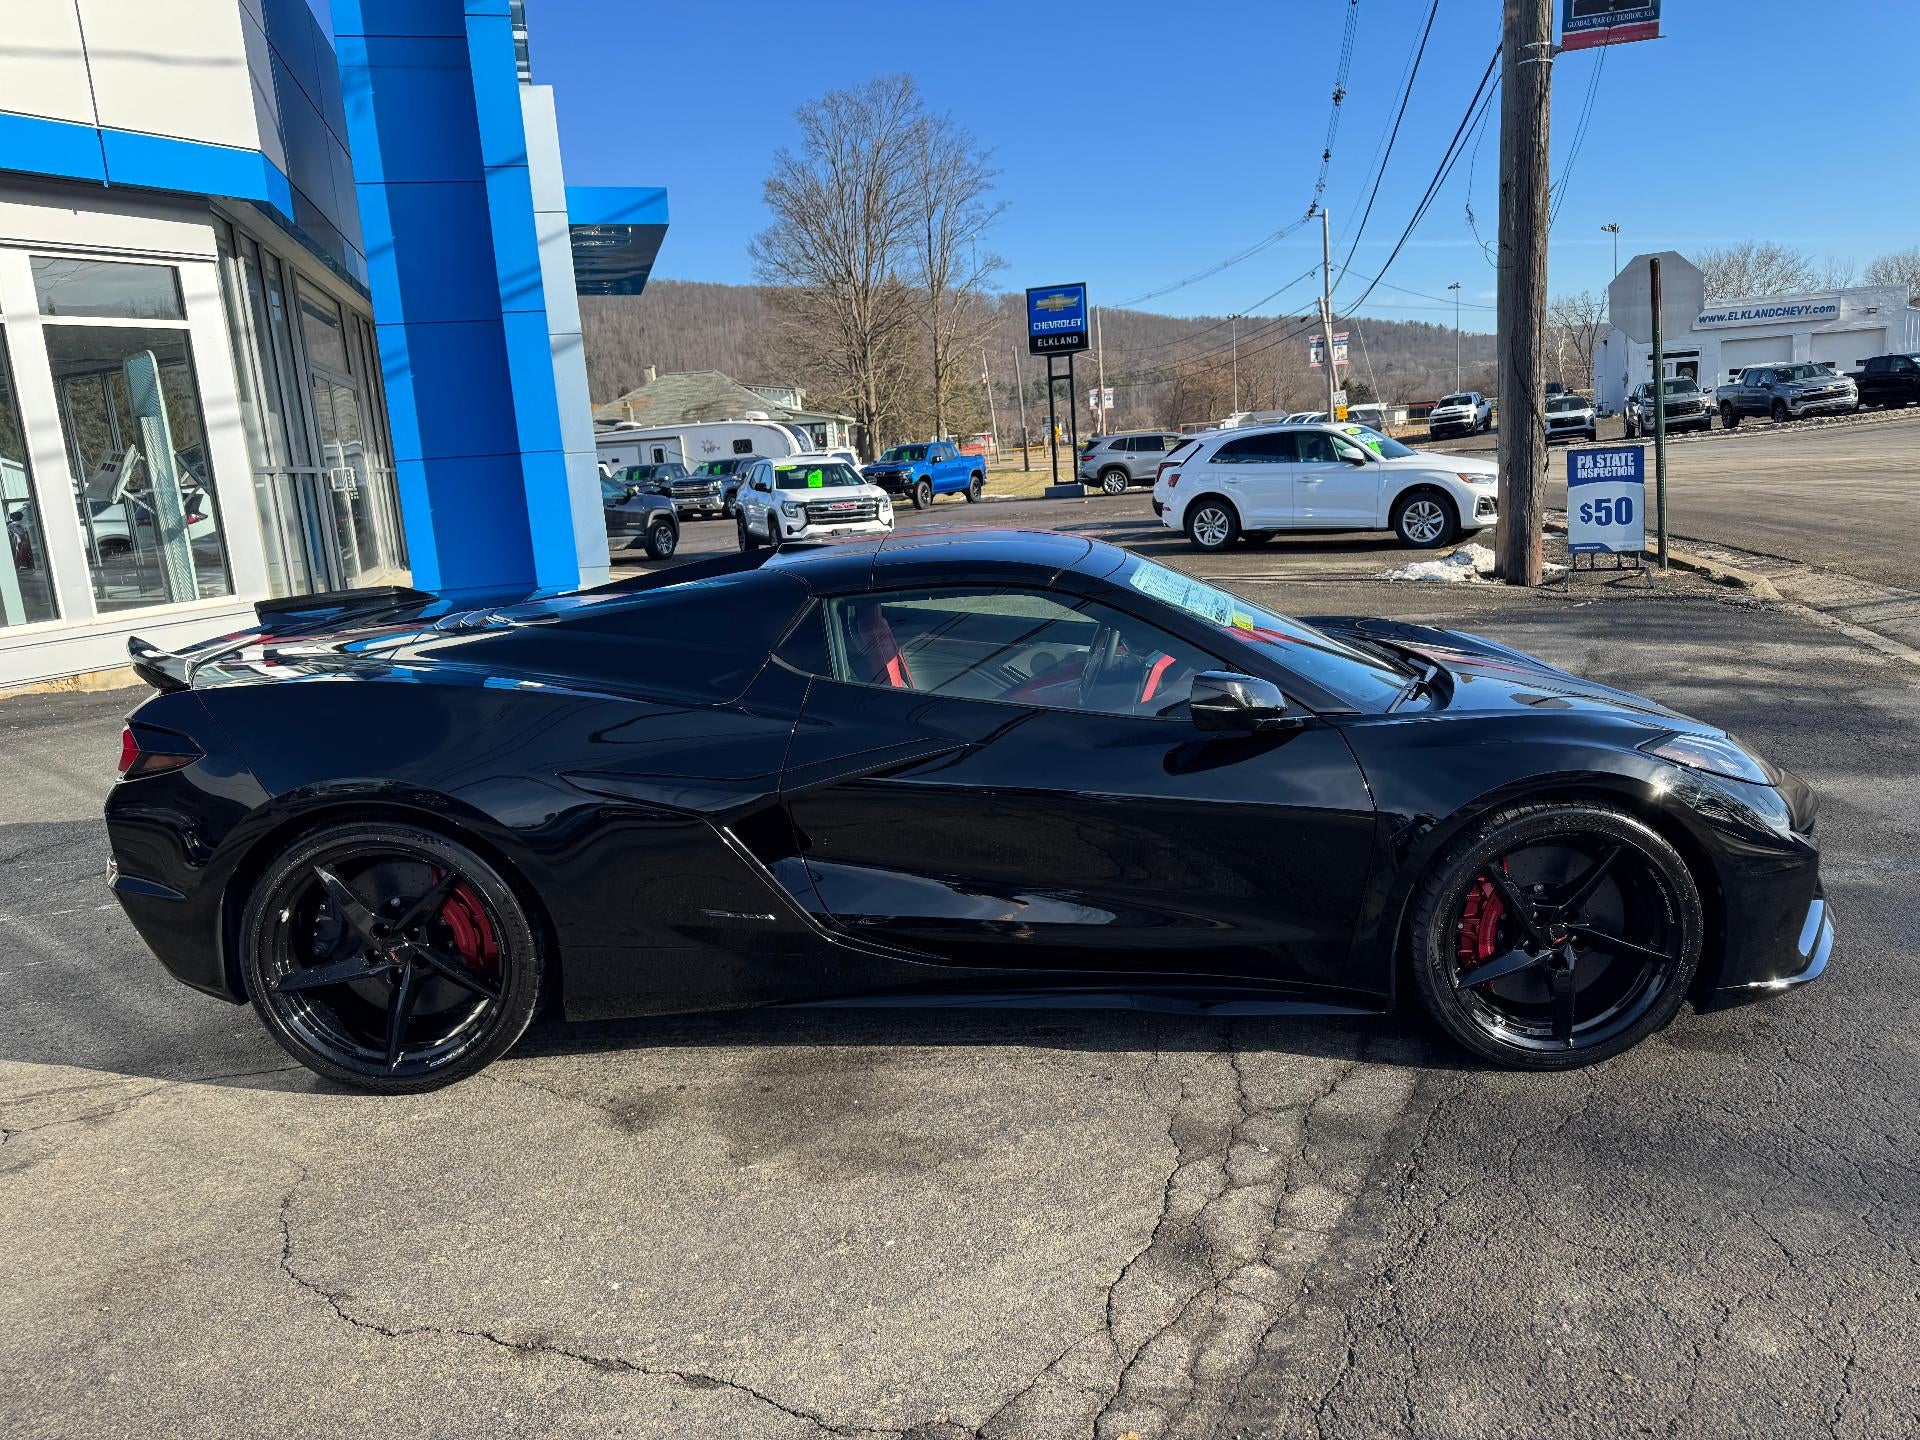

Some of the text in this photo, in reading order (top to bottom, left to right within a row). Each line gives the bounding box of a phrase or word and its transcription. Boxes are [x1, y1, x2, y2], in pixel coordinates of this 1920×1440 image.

[1567, 19, 1591, 28] GLOBAL
[1592, 17, 1606, 25] WAR
[1698, 304, 1836, 324] www.ELKLANDCHEVY.com
[1033, 318, 1082, 331] CHEVROLET
[1038, 335, 1079, 347] ELKLAND
[1577, 452, 1635, 468] PA STATE
[1577, 466, 1635, 479] INSPECTION
[1580, 496, 1633, 526] $50
